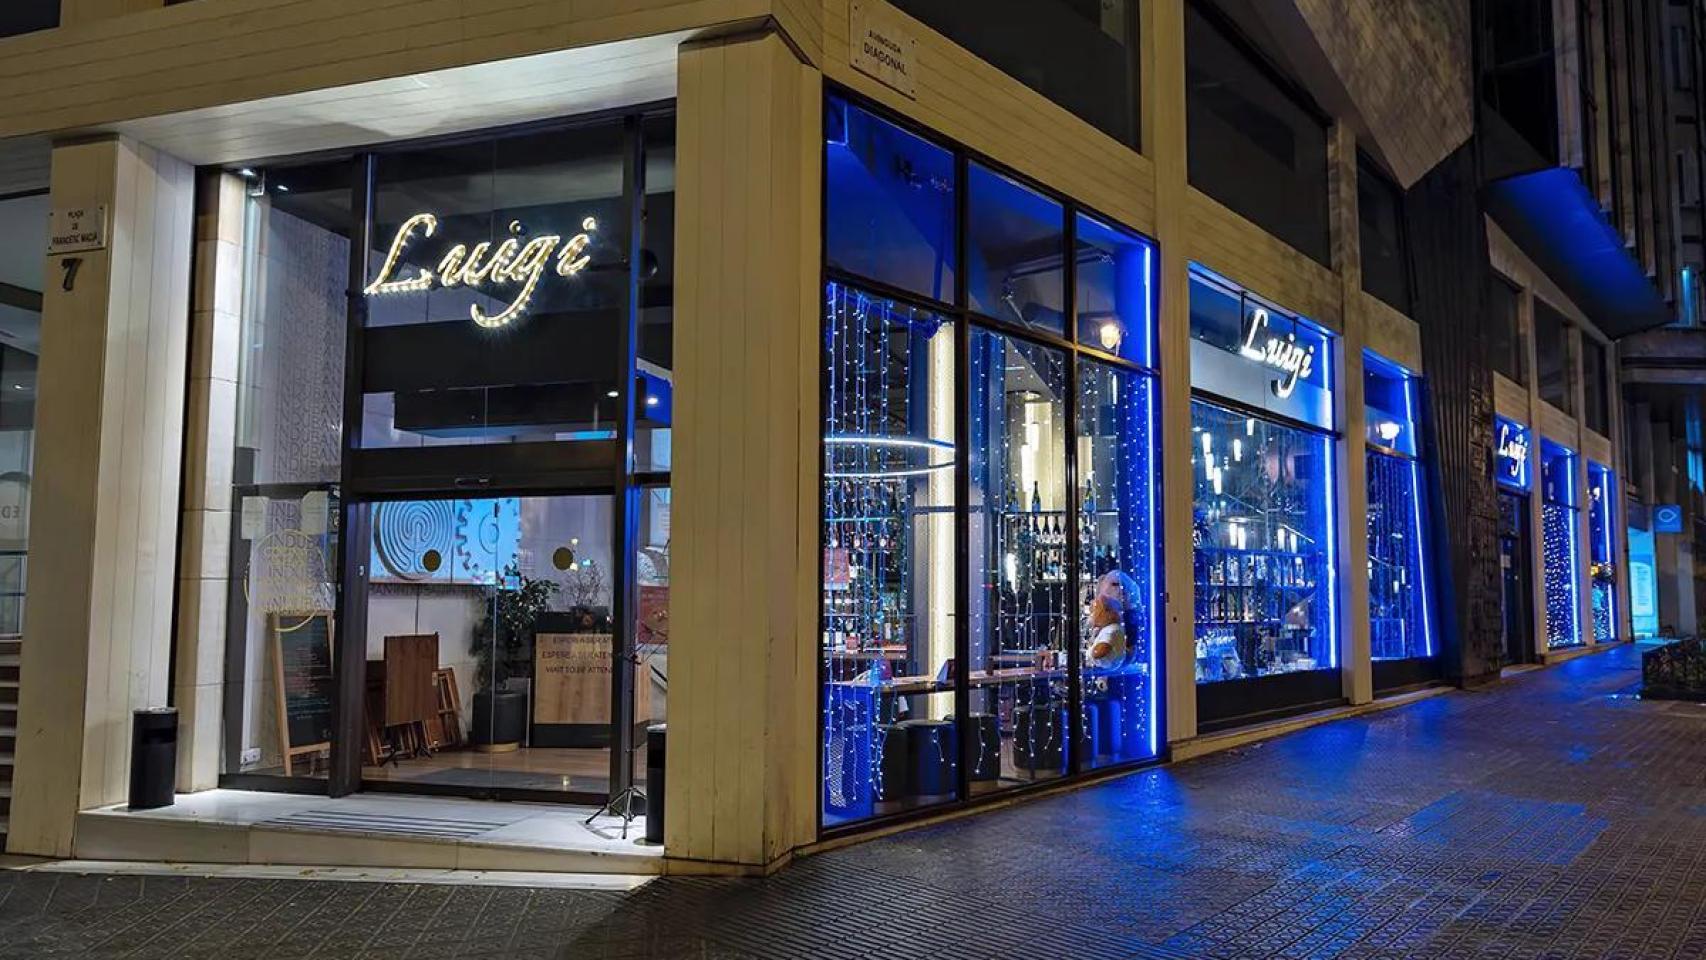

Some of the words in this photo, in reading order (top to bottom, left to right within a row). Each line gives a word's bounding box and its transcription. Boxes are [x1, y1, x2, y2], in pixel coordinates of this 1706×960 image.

[864, 42, 907, 76] DIAGONAL
[61, 258, 83, 291] 7
[364, 213, 597, 327] Luigi
[1241, 309, 1314, 398] Luigi
[1498, 423, 1528, 477] Luigi
